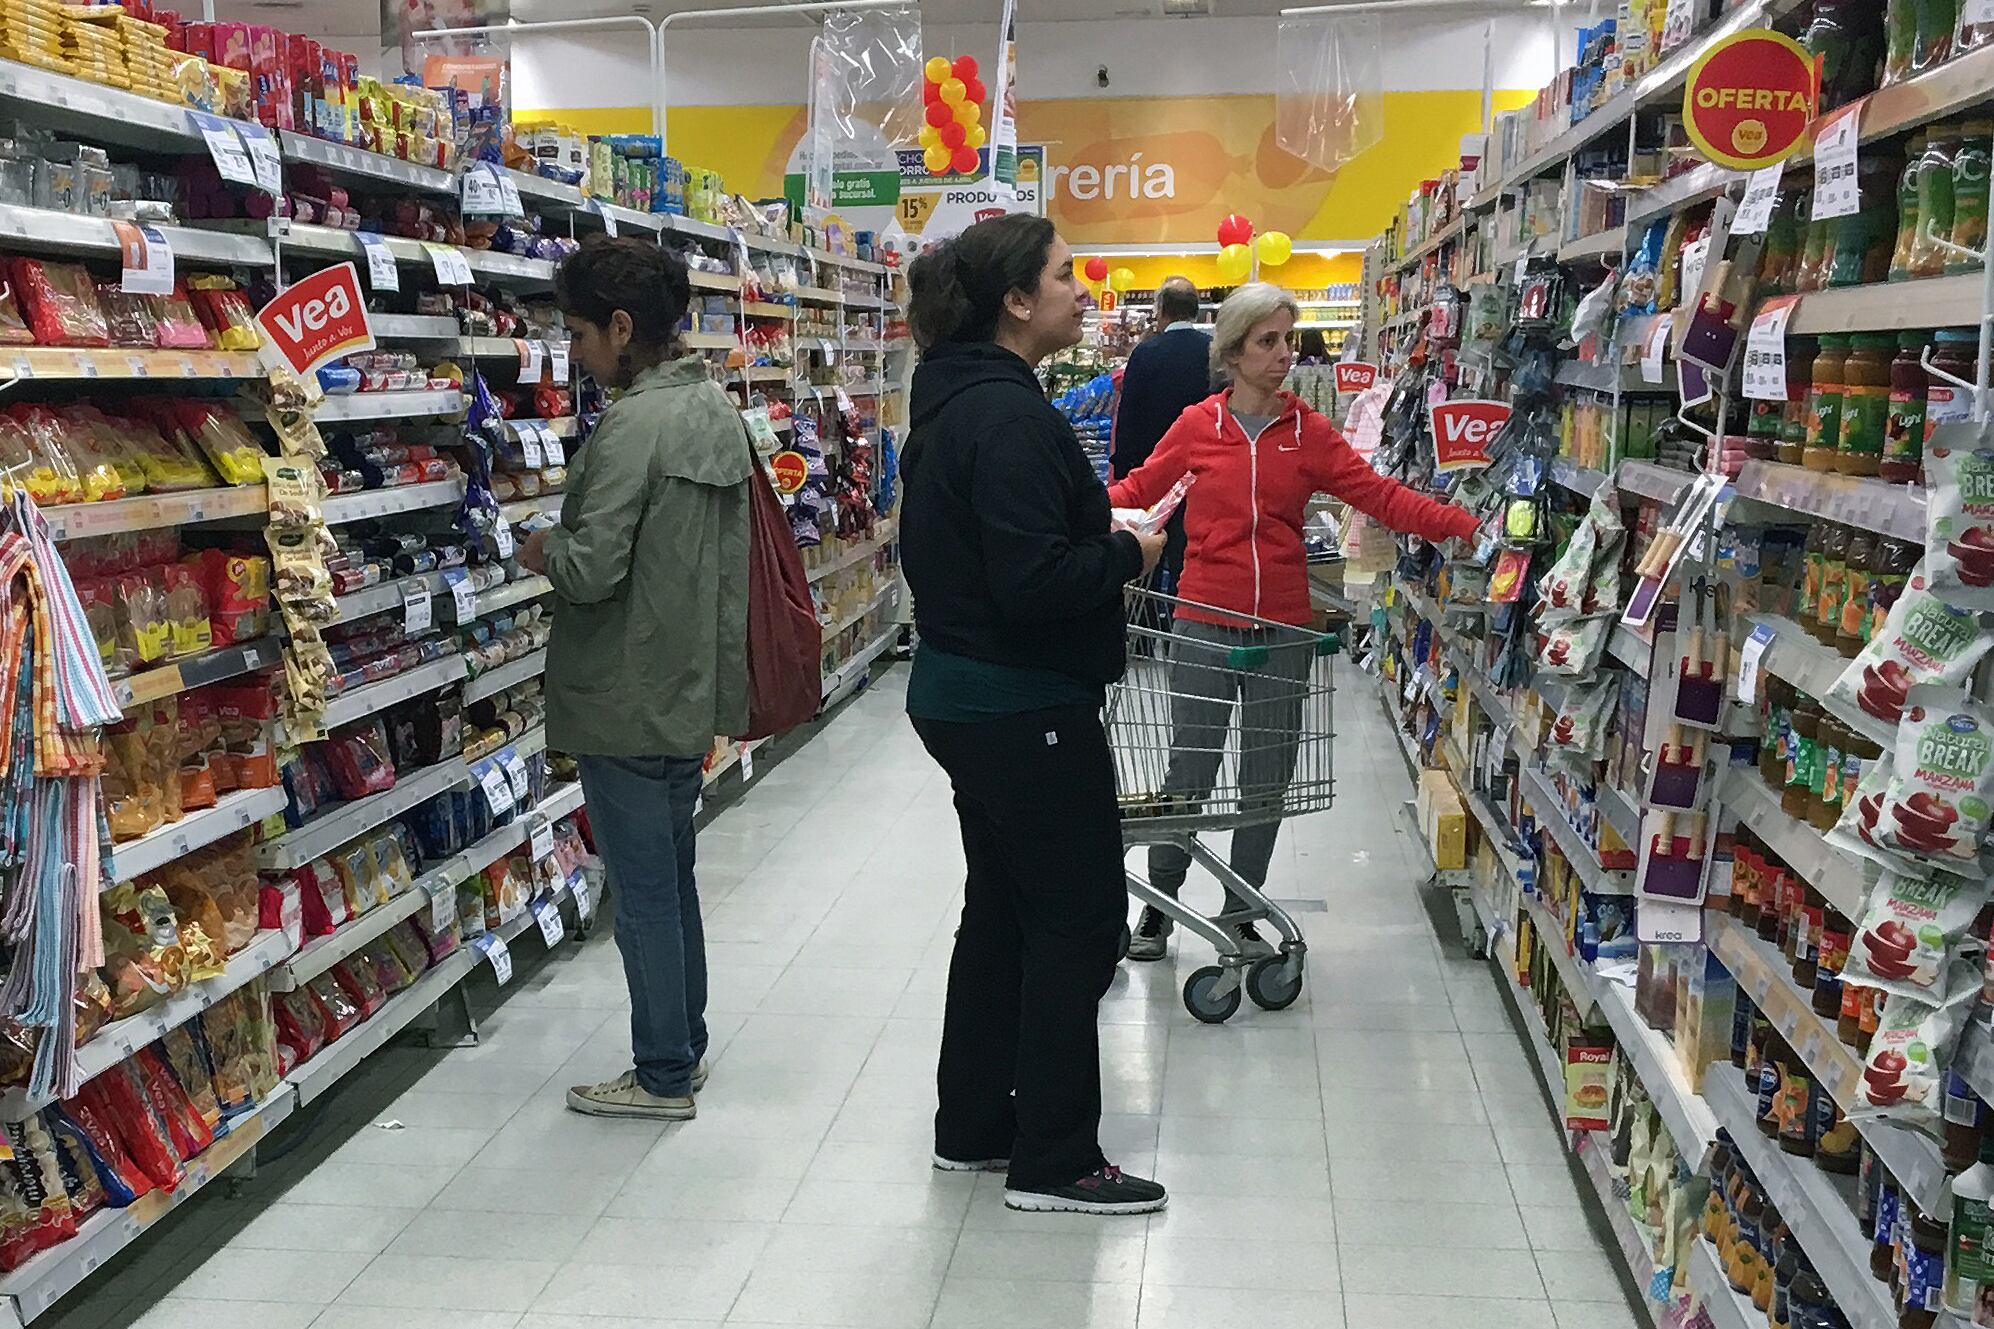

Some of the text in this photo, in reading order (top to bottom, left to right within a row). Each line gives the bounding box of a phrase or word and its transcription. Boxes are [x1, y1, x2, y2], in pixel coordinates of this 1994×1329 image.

[1696, 87, 1808, 112] OFERTA
[946, 190, 1036, 204] PRODUOS
[274, 284, 351, 344] Vea
[1340, 367, 1371, 384] Vea
[1904, 611, 1967, 662] BREAK
[1893, 636, 1947, 674] MANZANA
[1921, 740, 1985, 775] BREAK
[1914, 767, 1975, 792] MANZANA
[1655, 930, 1682, 940] krea
[1579, 1051, 1610, 1063] Royal
